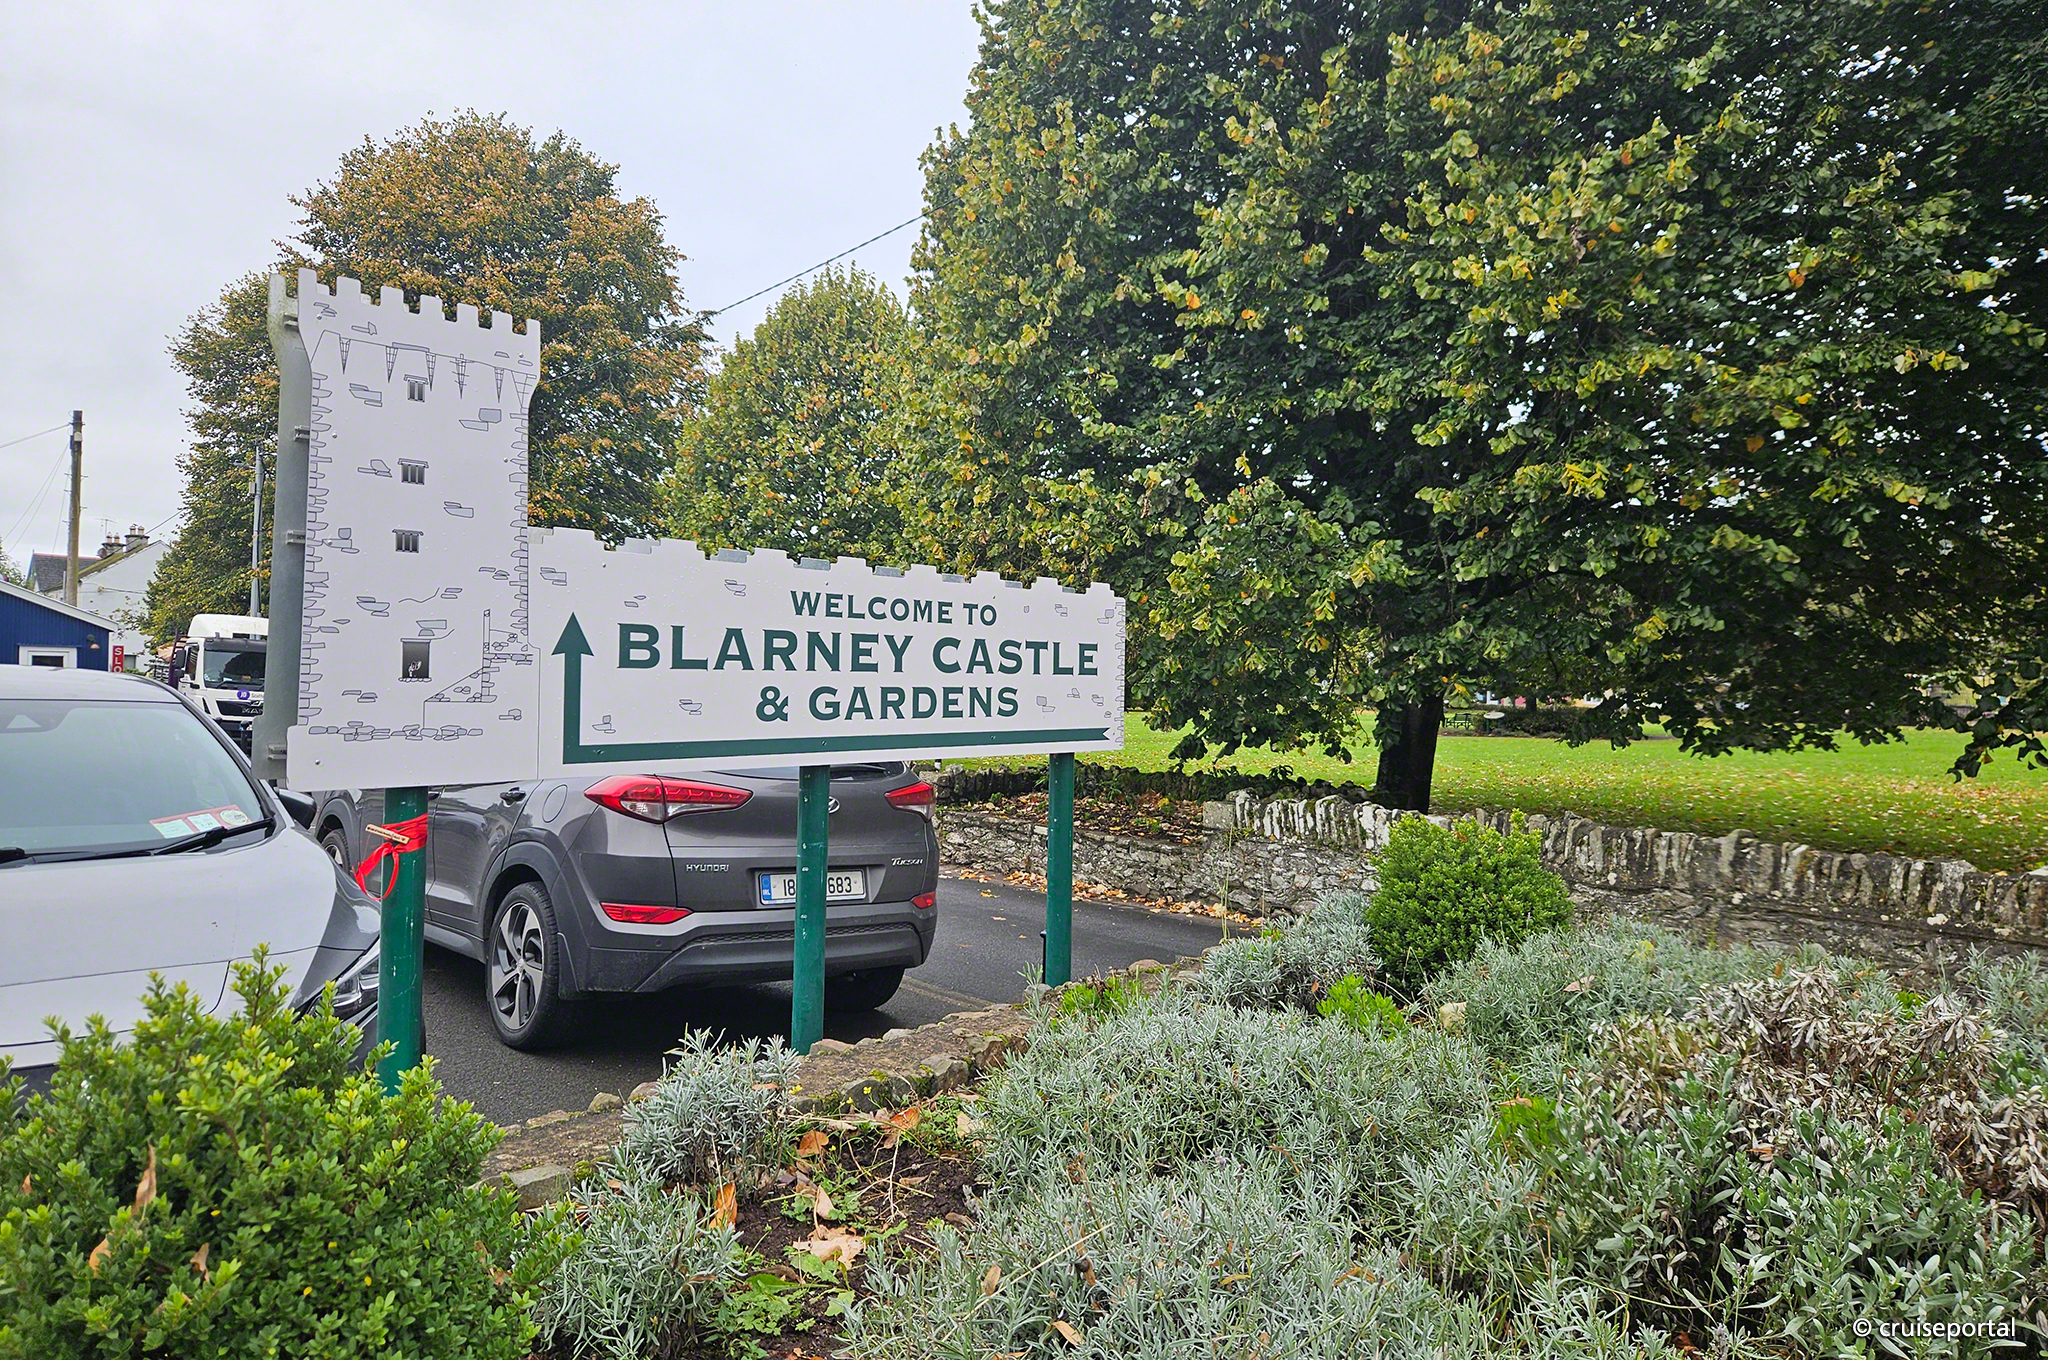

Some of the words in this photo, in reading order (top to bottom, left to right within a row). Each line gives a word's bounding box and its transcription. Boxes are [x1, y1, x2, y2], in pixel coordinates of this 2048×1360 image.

[790, 590, 953, 624] WELCOME
[962, 602, 998, 626] TO
[616, 622, 914, 674] BLARNEY
[932, 637, 1098, 676] CASTLE
[756, 685, 789, 722] &
[808, 685, 1020, 721] GARDENS
[686, 864, 729, 872] HYUNDAI
